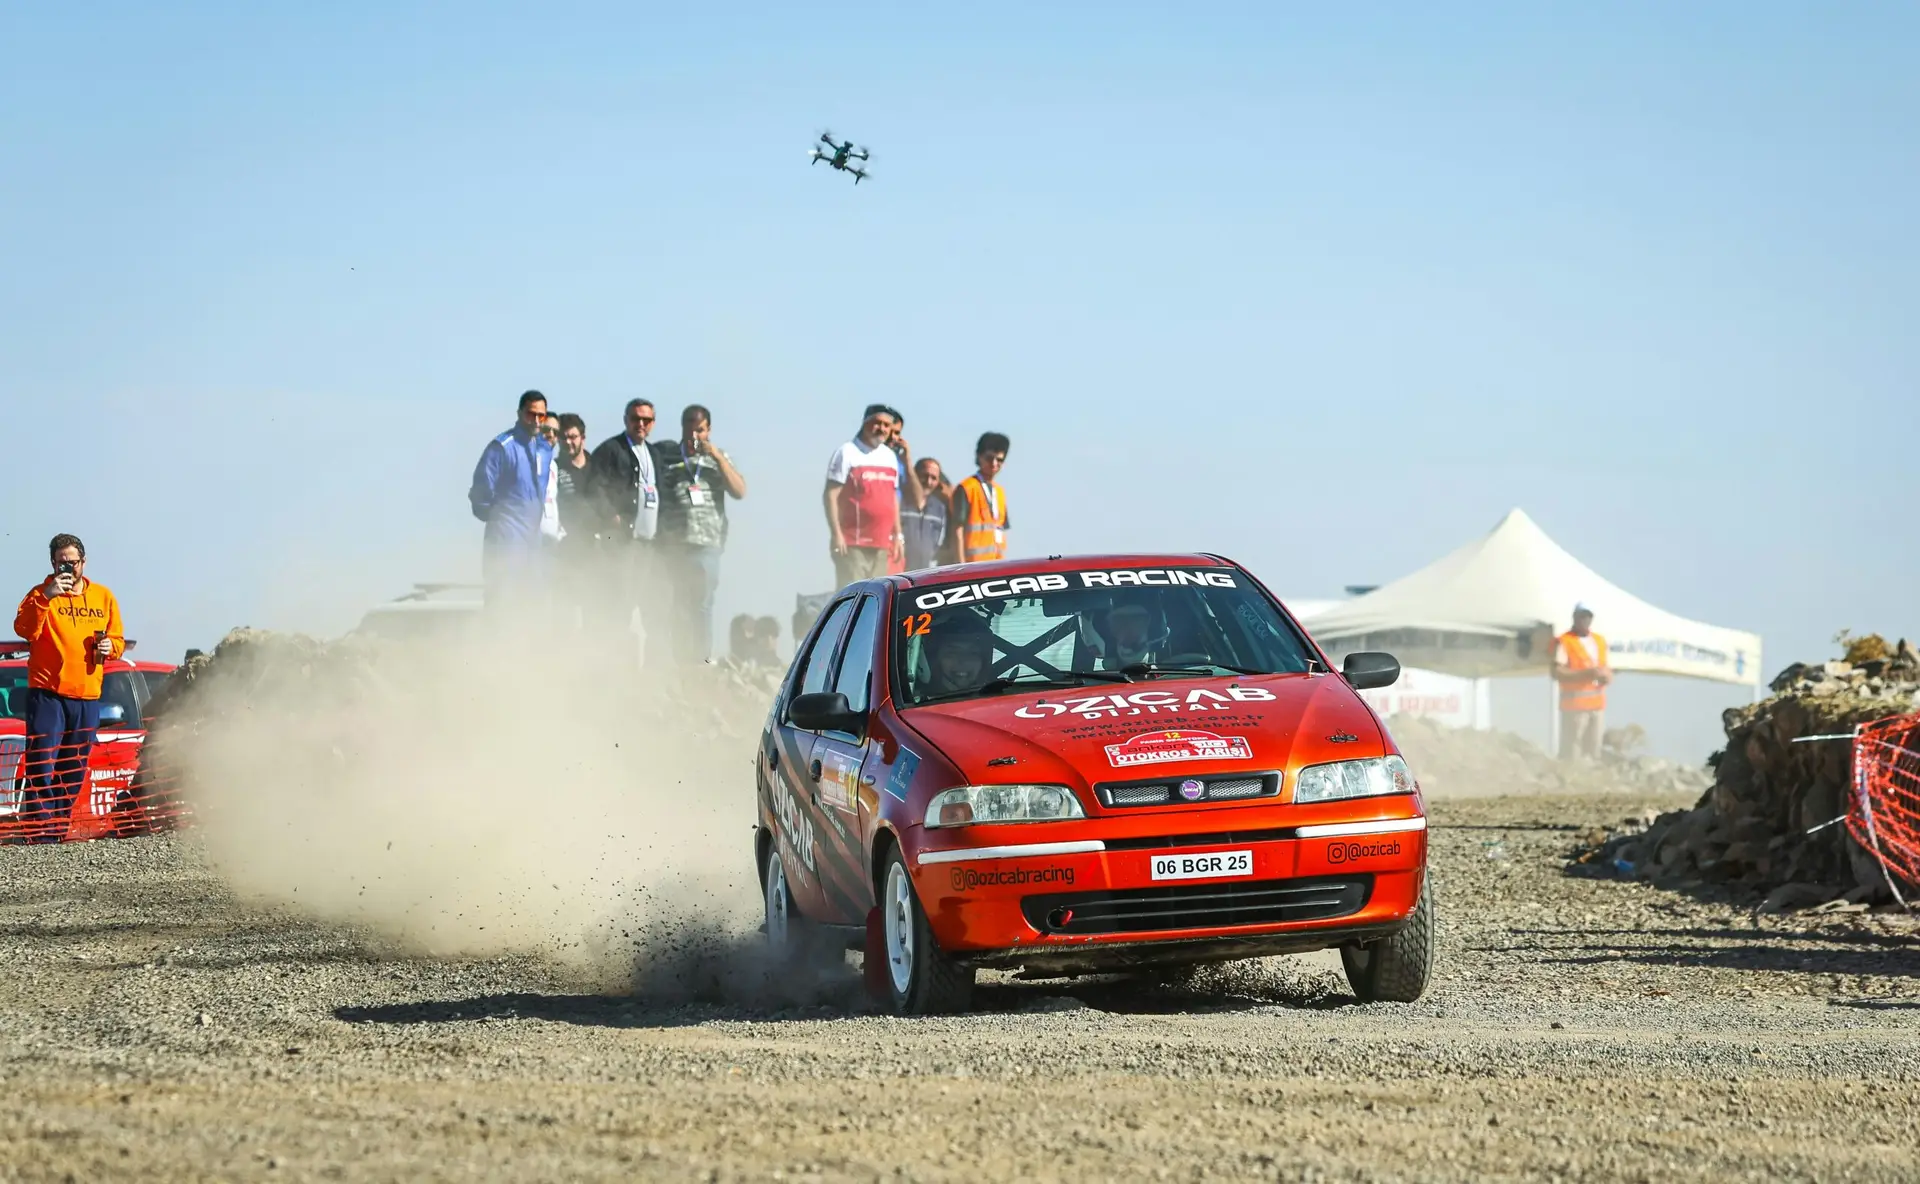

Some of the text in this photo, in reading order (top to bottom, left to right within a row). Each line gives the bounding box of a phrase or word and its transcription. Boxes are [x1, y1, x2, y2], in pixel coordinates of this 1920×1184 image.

[915, 570, 1237, 610] OZICAB RACING
[903, 612, 932, 637] 12
[1014, 688, 1277, 719] OZICAB
[1061, 715, 1264, 733] www.ozicab.com.tr
[1116, 749, 1191, 763] OTOKROS
[1348, 840, 1400, 861] @ozicab
[965, 864, 1075, 890] @ozicabracing
[1157, 856, 1248, 875] 06 BGR 25
